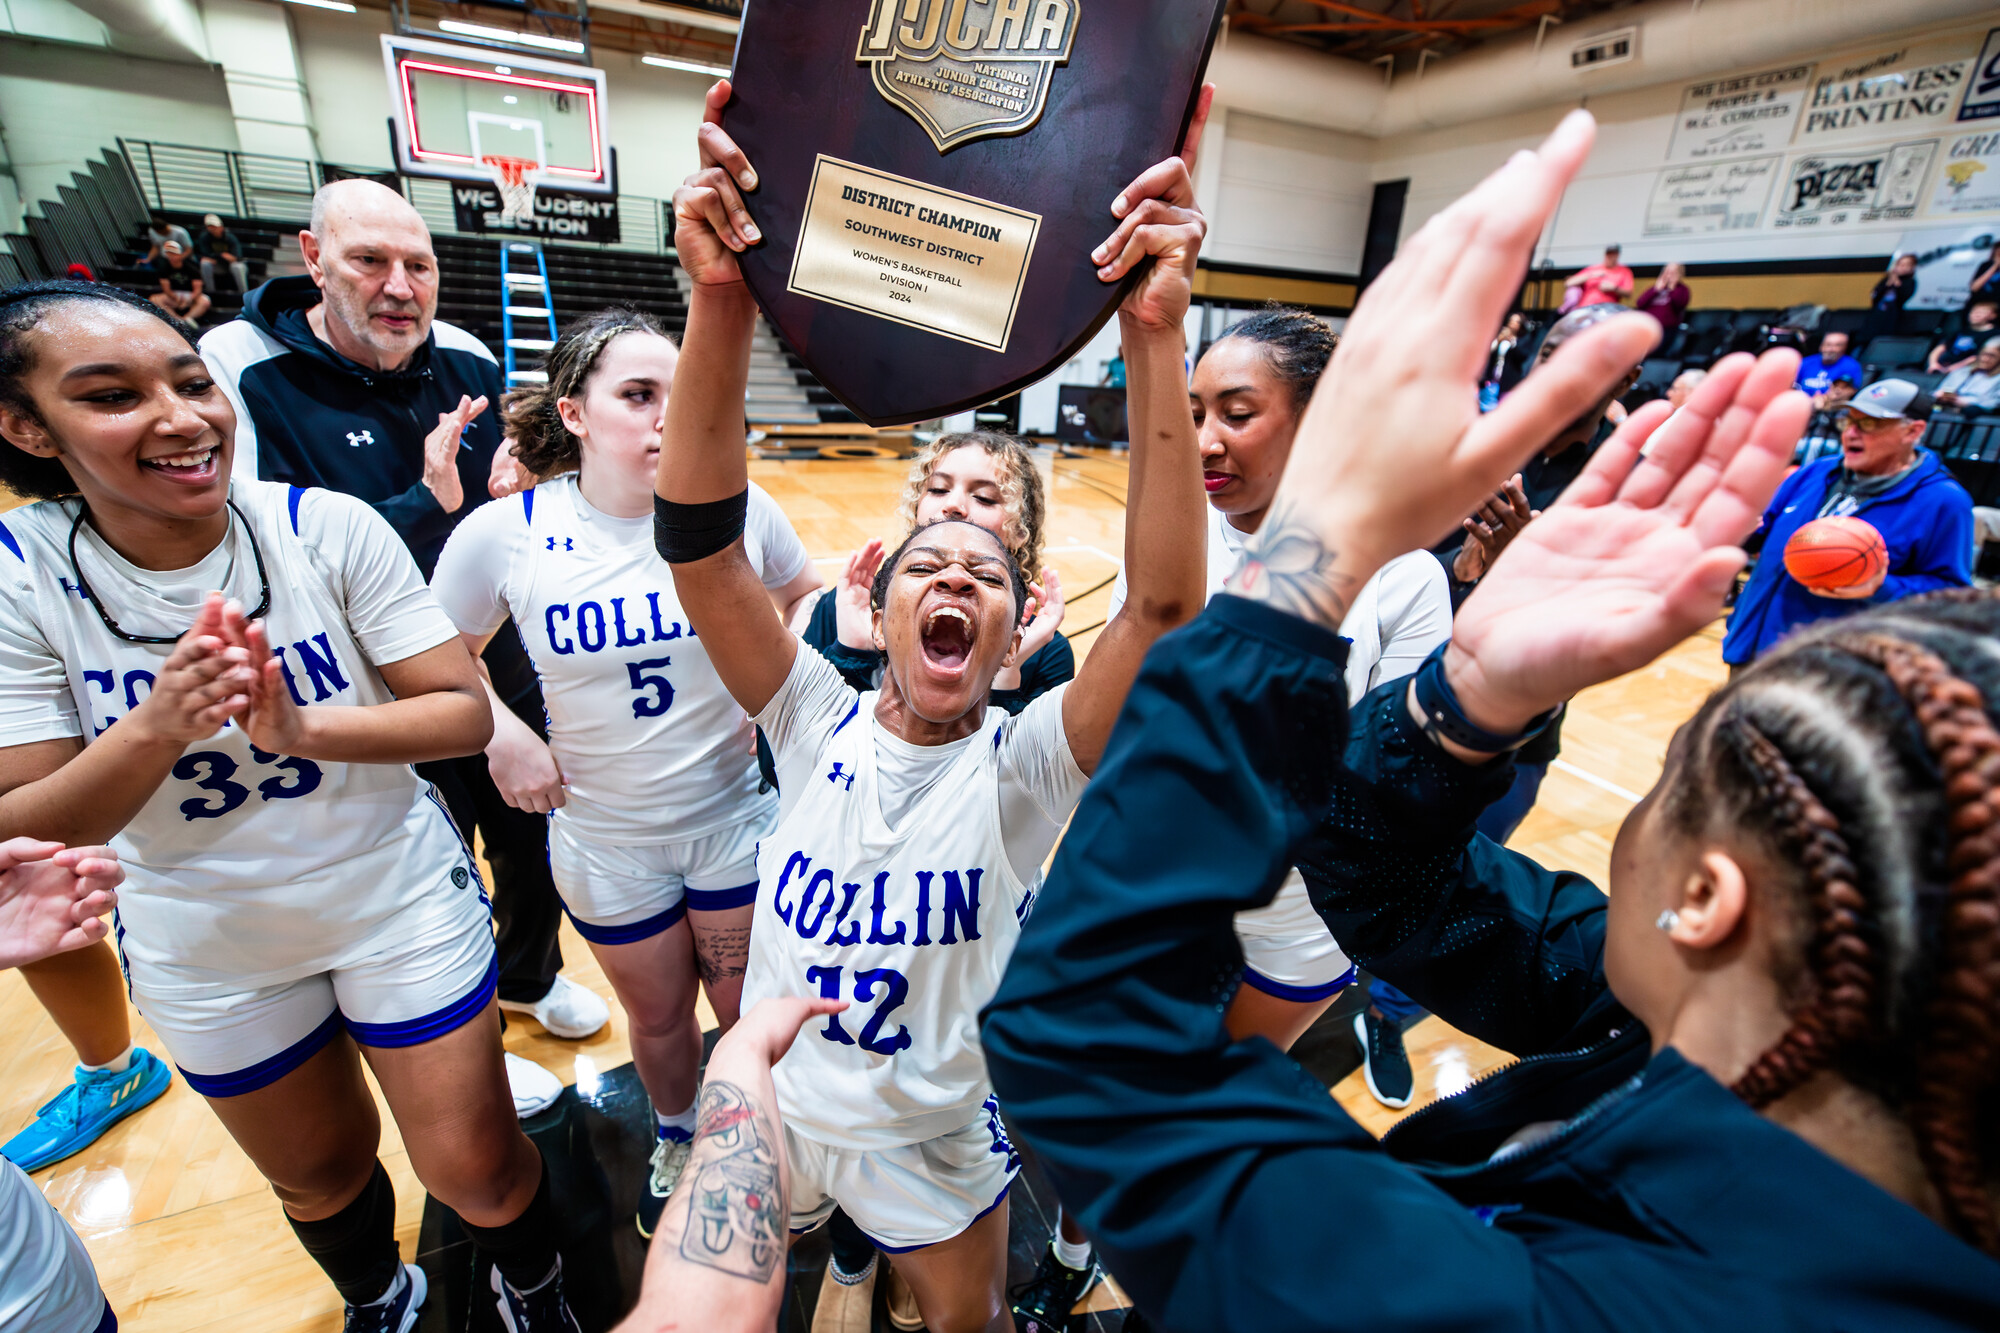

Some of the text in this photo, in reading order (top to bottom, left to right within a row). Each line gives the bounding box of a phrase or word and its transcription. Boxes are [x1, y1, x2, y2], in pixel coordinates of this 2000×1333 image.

[896, 70, 1024, 113] ATHLETIC ASSOCIATION
[936, 67, 1027, 99] JUNIOR COLLEGE
[974, 62, 1029, 86] NATIONAL
[1806, 91, 1948, 133] PRINTING
[1791, 158, 1884, 211] PIZZA
[483, 211, 588, 235] SECTION
[534, 195, 614, 219] UDENT
[841, 185, 1002, 243] DISTRICT CHAMPION
[844, 219, 984, 266] SOUTHWEST DISTRICT
[852, 249, 962, 288] WOMEN'S BASKETBALL
[879, 272, 922, 292] DIVISION
[888, 291, 912, 304] 2024
[545, 592, 698, 655] COLLI
[625, 656, 676, 719] 5
[774, 851, 984, 947] COLLIN
[806, 964, 912, 1056] 12
